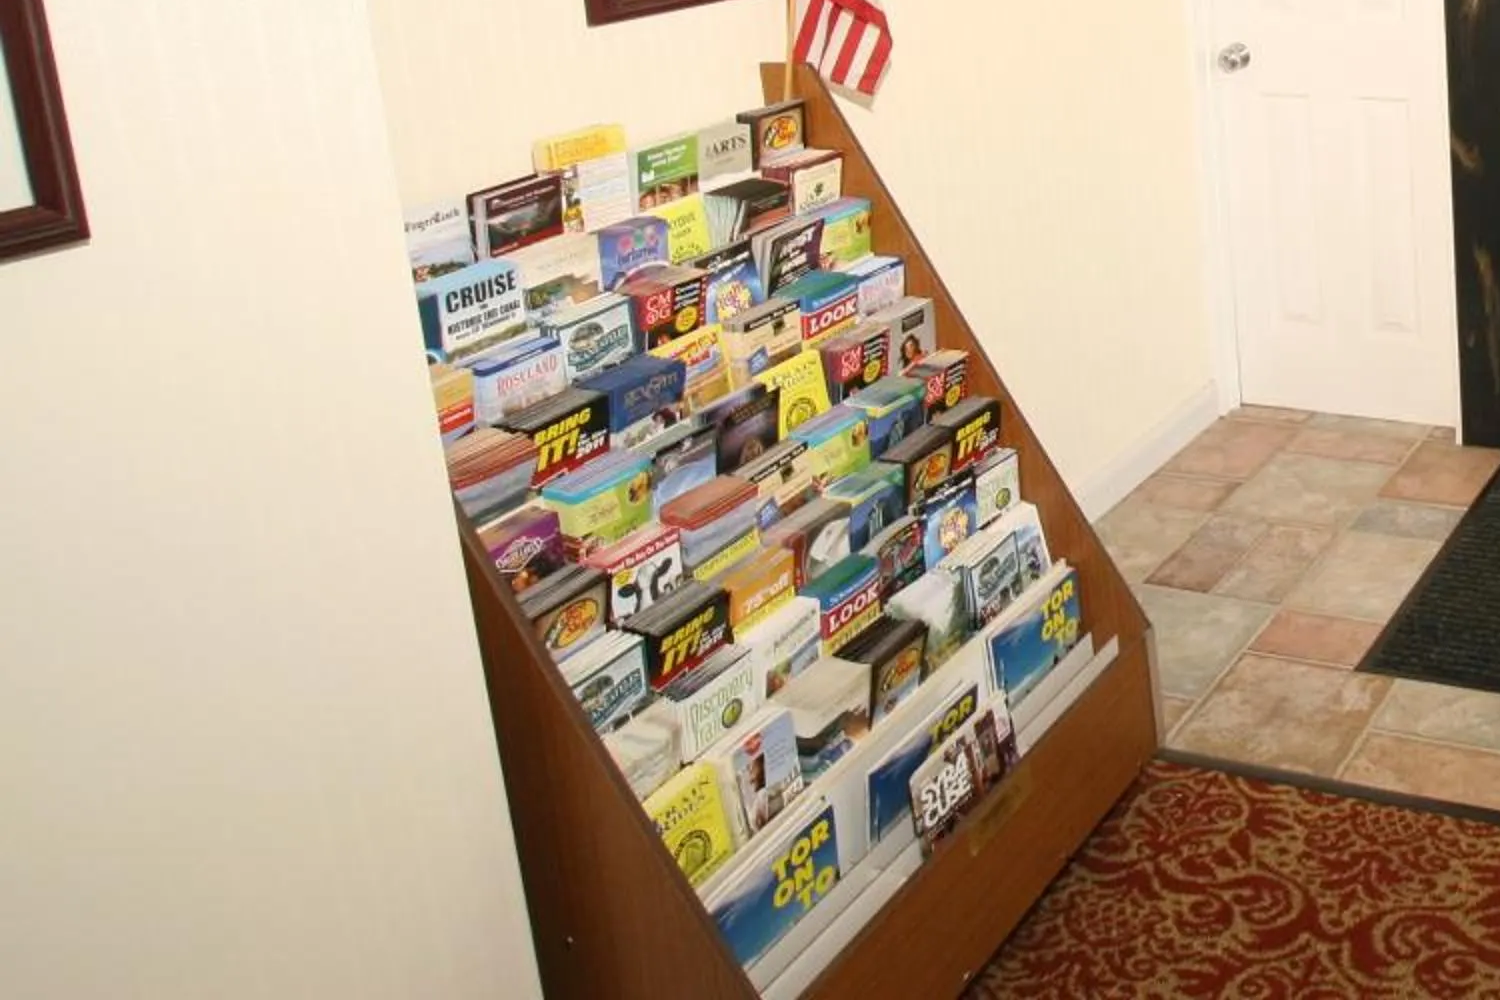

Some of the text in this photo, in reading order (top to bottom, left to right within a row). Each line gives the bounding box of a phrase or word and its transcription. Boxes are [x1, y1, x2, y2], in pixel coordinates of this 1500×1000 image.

[444, 269, 517, 314] CRUISE
[809, 300, 858, 335] LOOK
[534, 407, 592, 446] BRING
[829, 582, 880, 633] LOOK
[1039, 579, 1074, 617] TOR
[660, 605, 715, 653] BRING
[1041, 607, 1066, 641] ON
[929, 694, 973, 744] TOR
[771, 819, 830, 881] TOR
[773, 857, 815, 908] ON
[798, 865, 836, 909] TO
